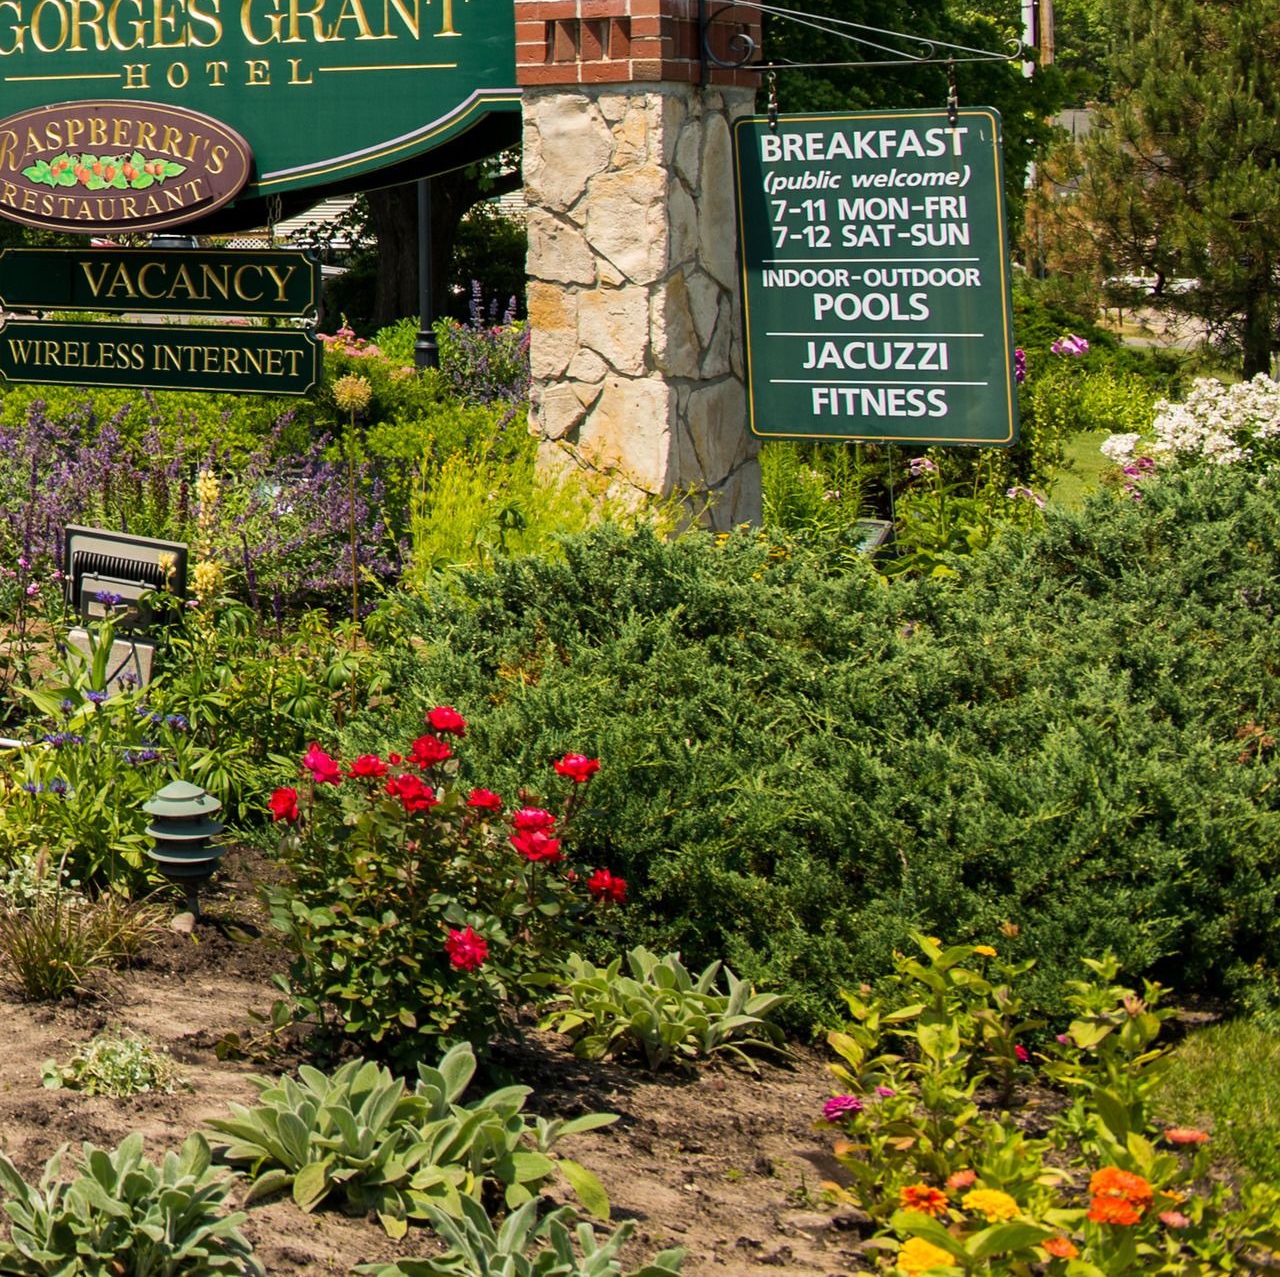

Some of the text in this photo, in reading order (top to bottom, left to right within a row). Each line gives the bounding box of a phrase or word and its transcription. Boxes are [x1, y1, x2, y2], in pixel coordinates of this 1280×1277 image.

[121, 58, 314, 90] HOTEL
[760, 127, 968, 163] BREAKFAST
[763, 165, 972, 195] (public welcome)
[0, 177, 206, 222] RESTAURANT
[771, 196, 968, 222] 7-11 MON-FRI
[772, 222, 971, 248] 7-12 SAT-SUN
[78, 260, 298, 303] VACANCY
[761, 267, 982, 288] INDOOR-OUTDOOR
[812, 292, 931, 322] POOLS
[7, 337, 305, 378] WIRELESS INTERNET
[802, 341, 949, 371] JACUZZI
[811, 386, 949, 418] FITNESS
